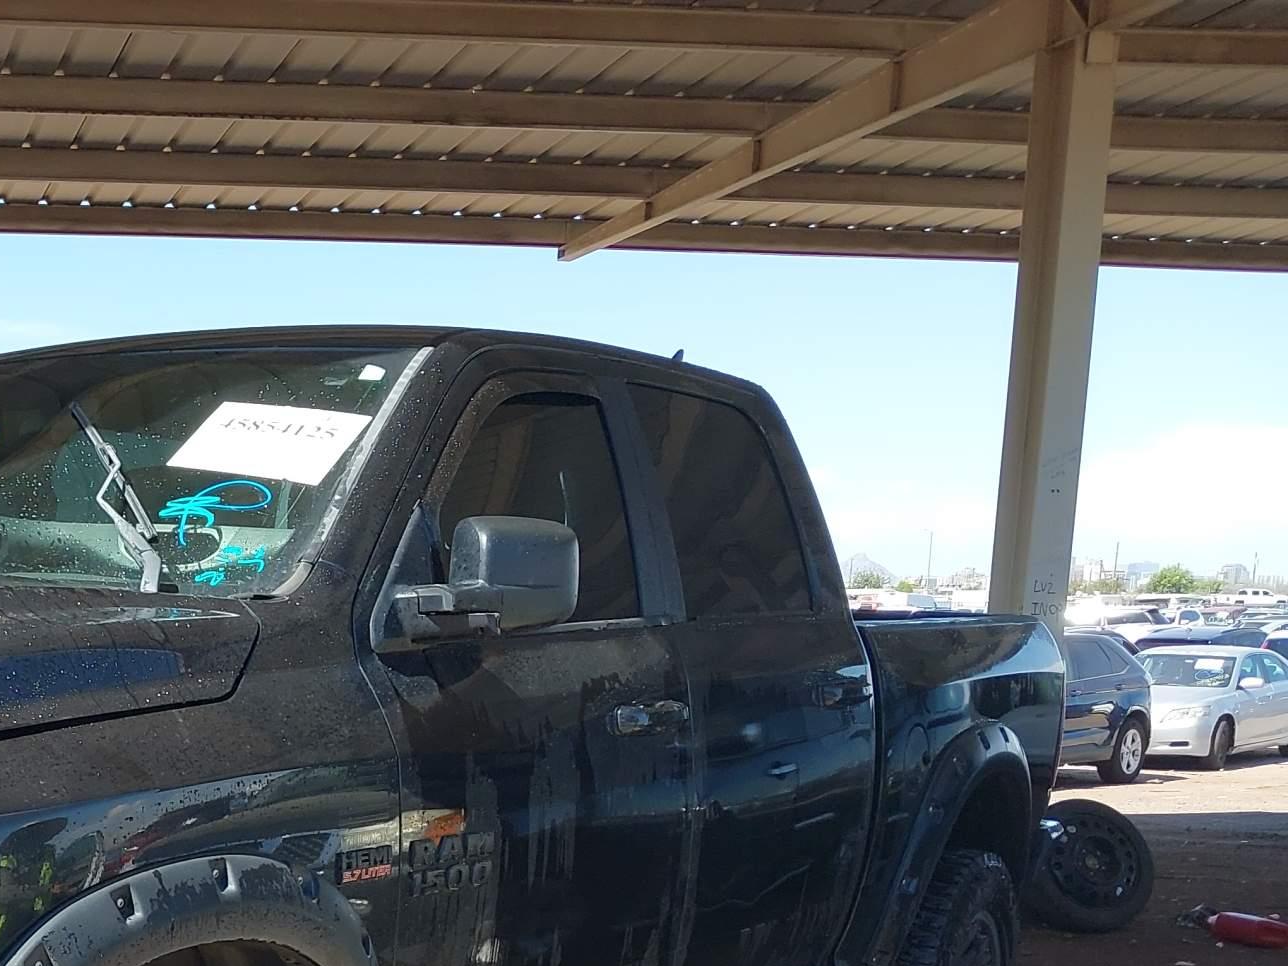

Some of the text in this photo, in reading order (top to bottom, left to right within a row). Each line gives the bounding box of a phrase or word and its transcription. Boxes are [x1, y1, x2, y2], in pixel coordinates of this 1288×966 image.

[219, 418, 339, 439] 45854125
[342, 845, 393, 870] HEMI
[409, 832, 495, 870] RAM
[361, 864, 392, 880] LITER
[410, 860, 493, 897] 1500
